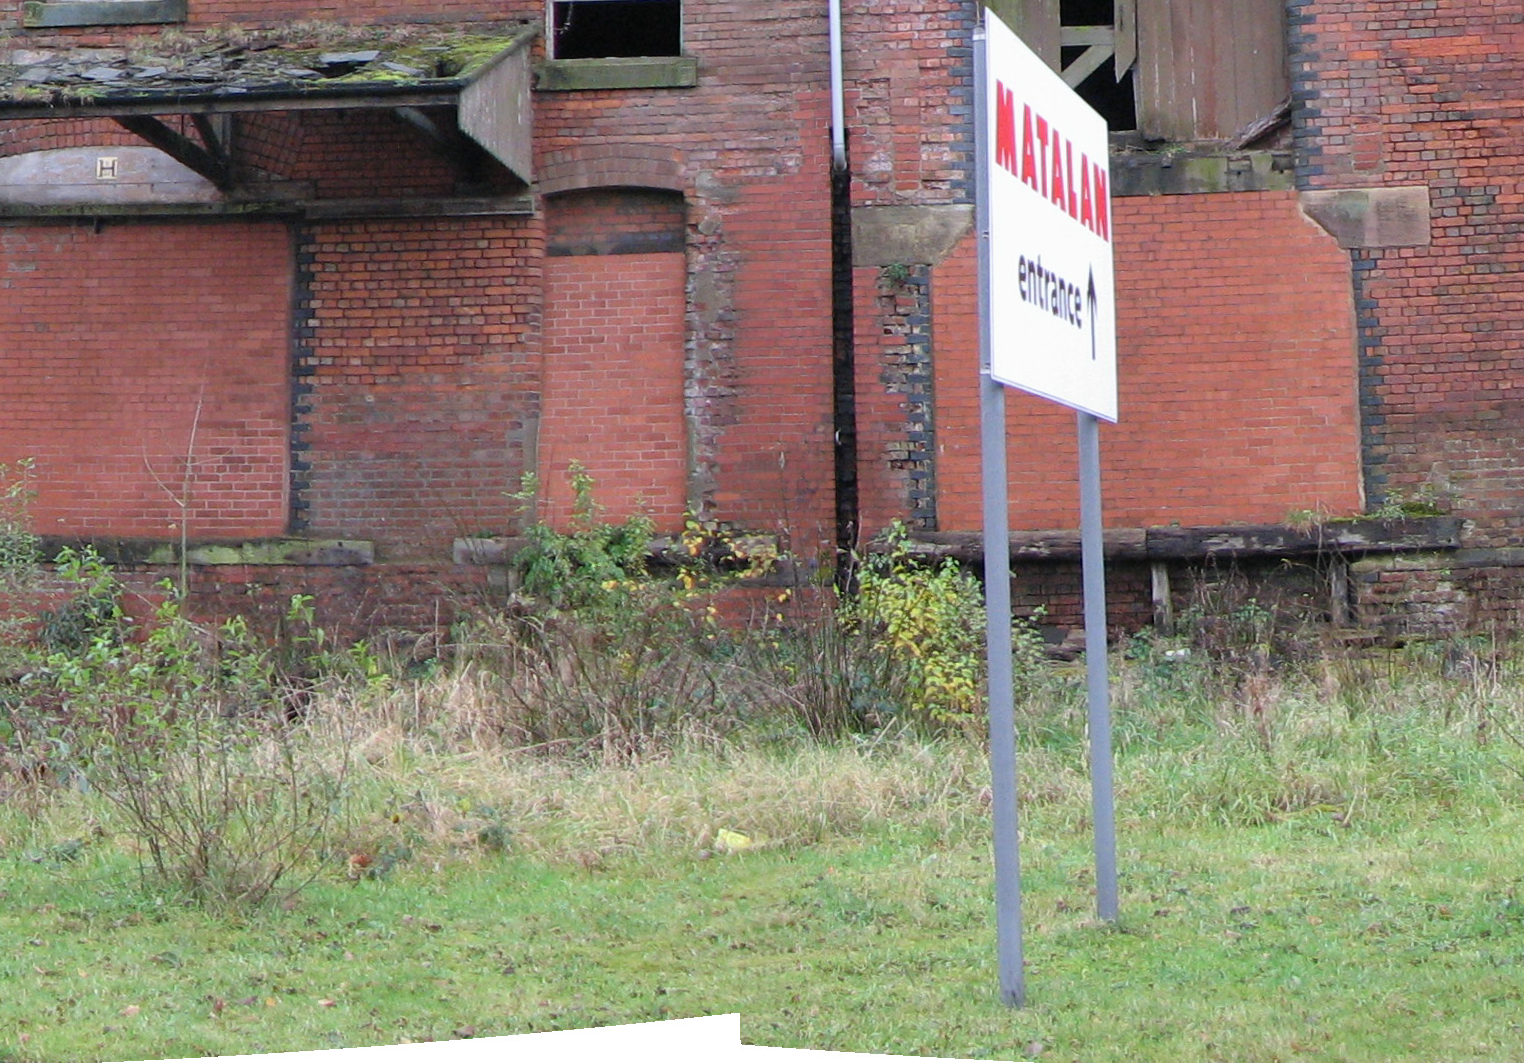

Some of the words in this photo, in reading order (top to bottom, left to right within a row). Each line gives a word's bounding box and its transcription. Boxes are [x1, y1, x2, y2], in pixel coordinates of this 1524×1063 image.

[99, 160, 115, 177] H
[996, 79, 1108, 243] MATALAN
[1019, 255, 1082, 329] entrance
